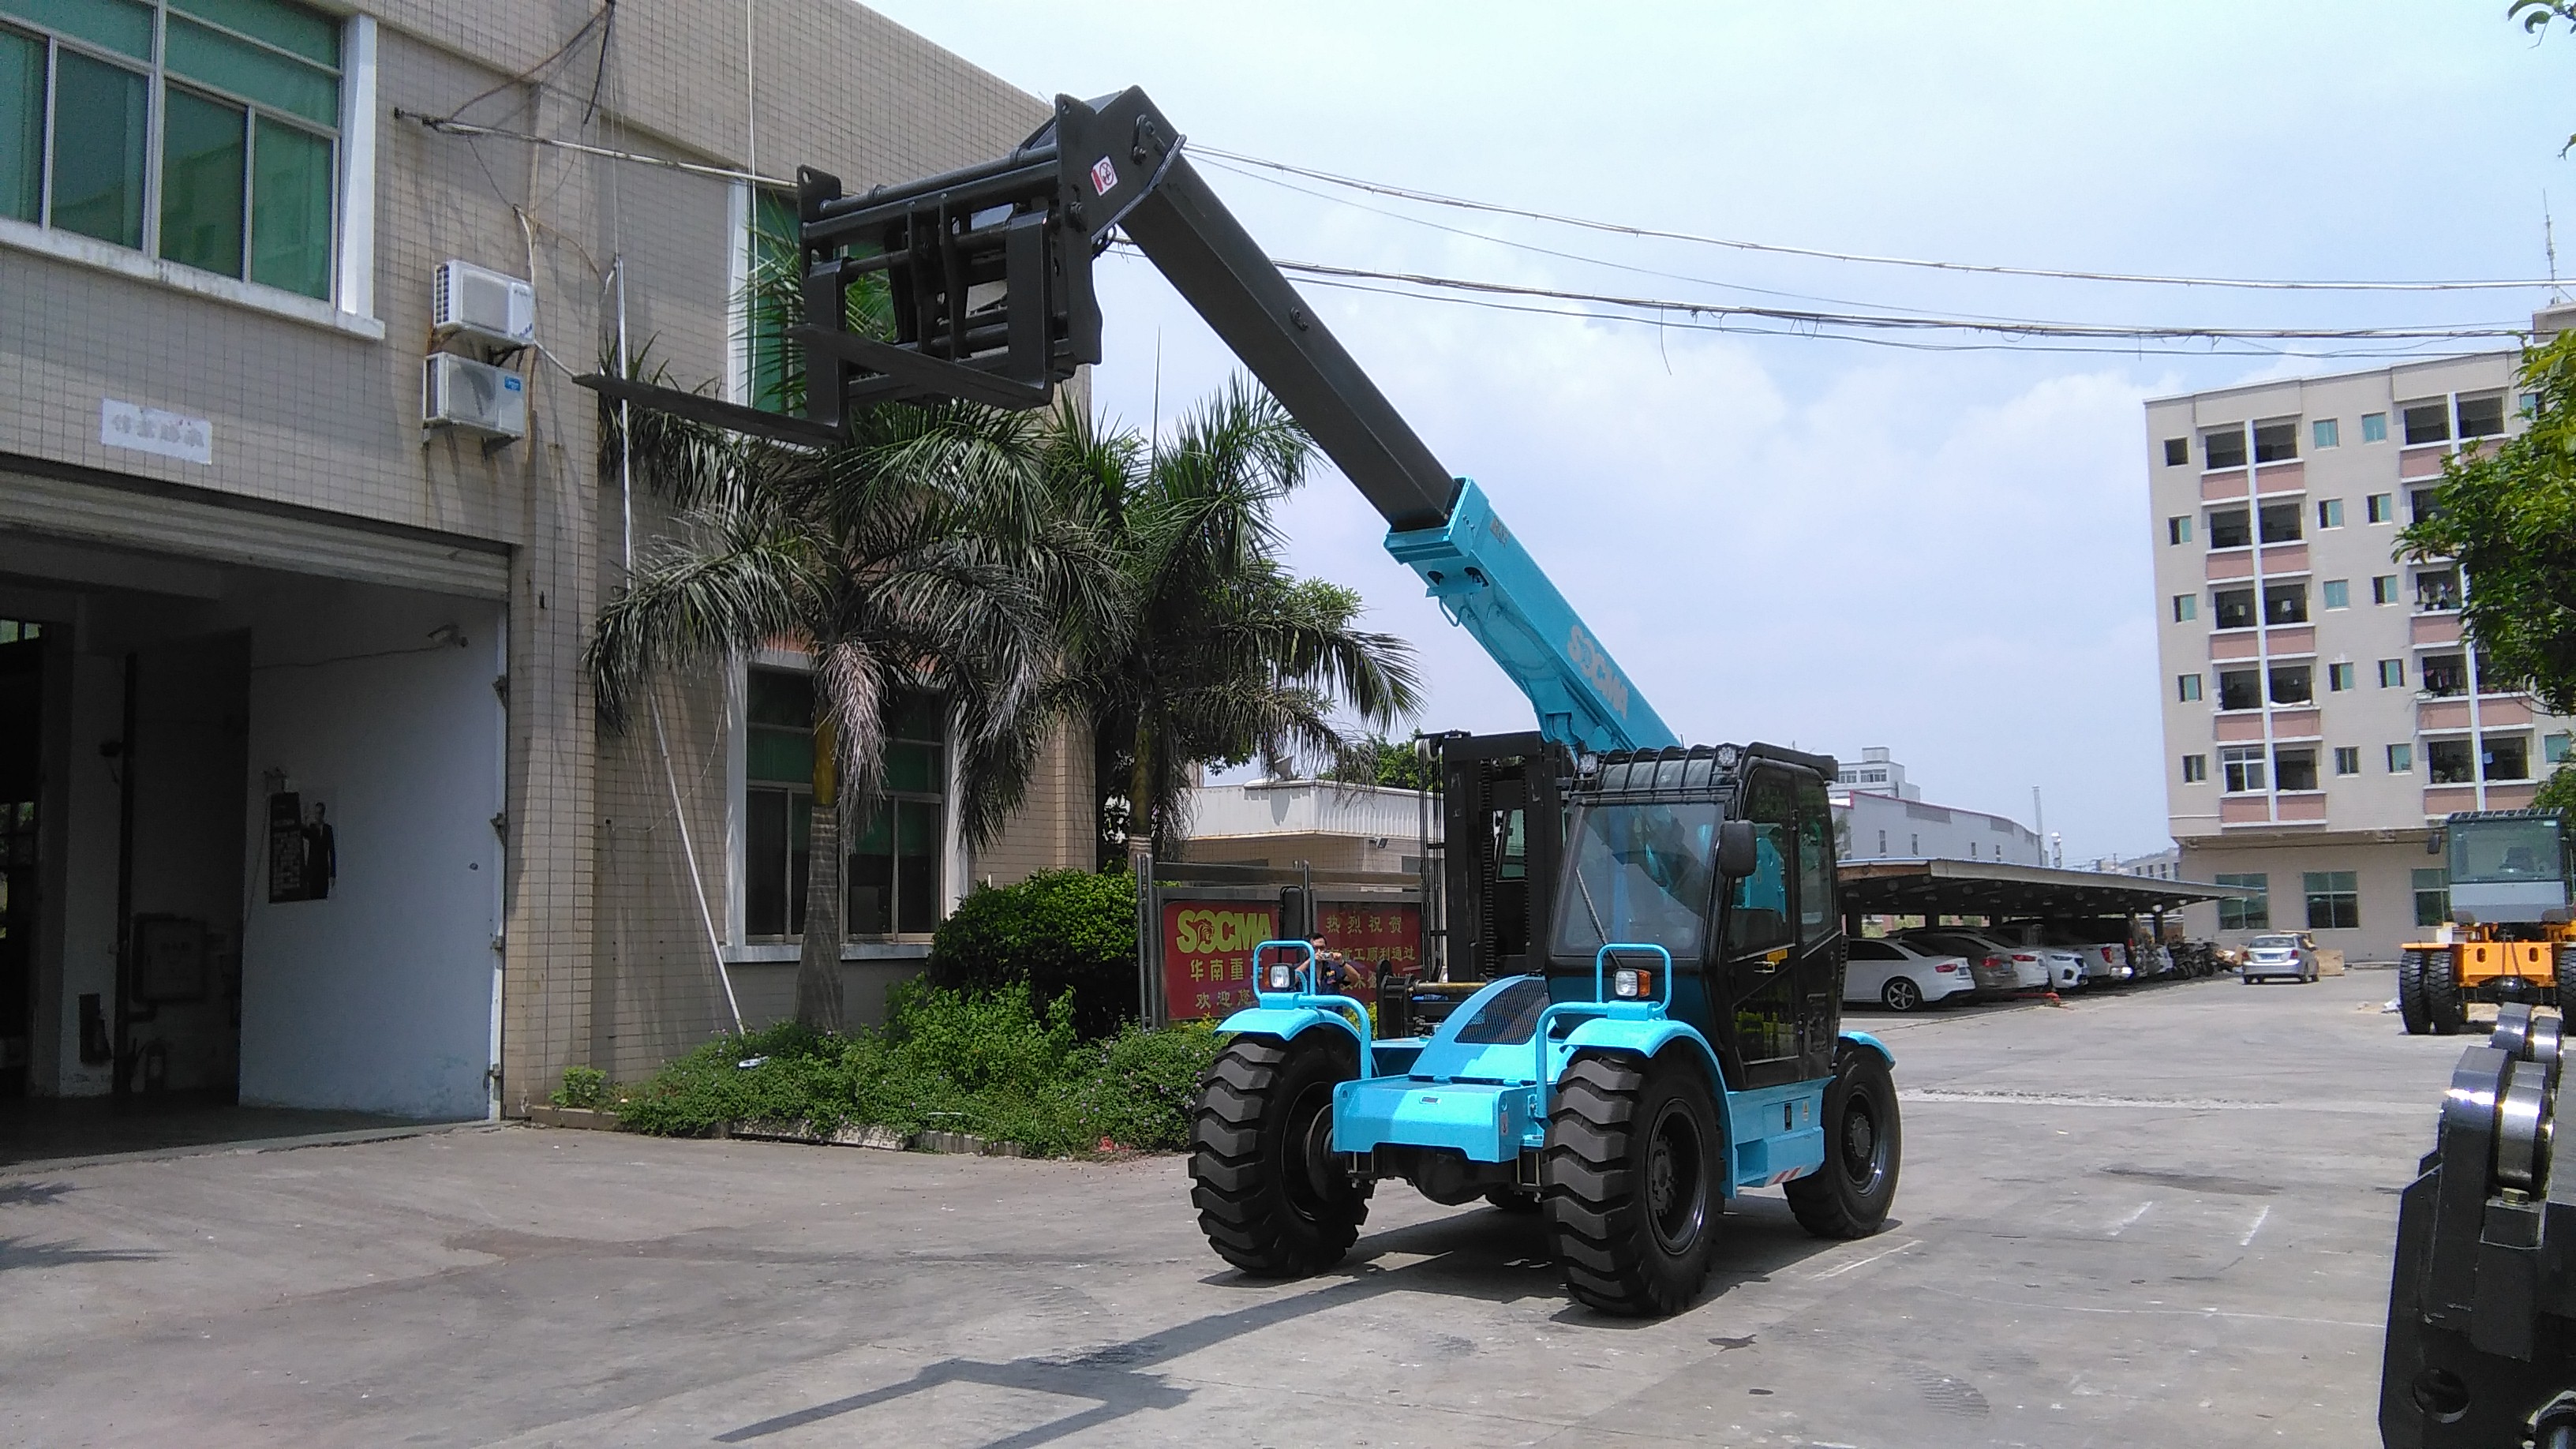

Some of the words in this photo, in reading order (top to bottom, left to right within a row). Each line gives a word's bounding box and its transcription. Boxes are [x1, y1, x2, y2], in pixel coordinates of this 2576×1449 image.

[1176, 909, 1274, 954] SOCMA
[1326, 915, 1402, 934] 热烈祝贺
[1327, 945, 1416, 961] 重工顺利通过
